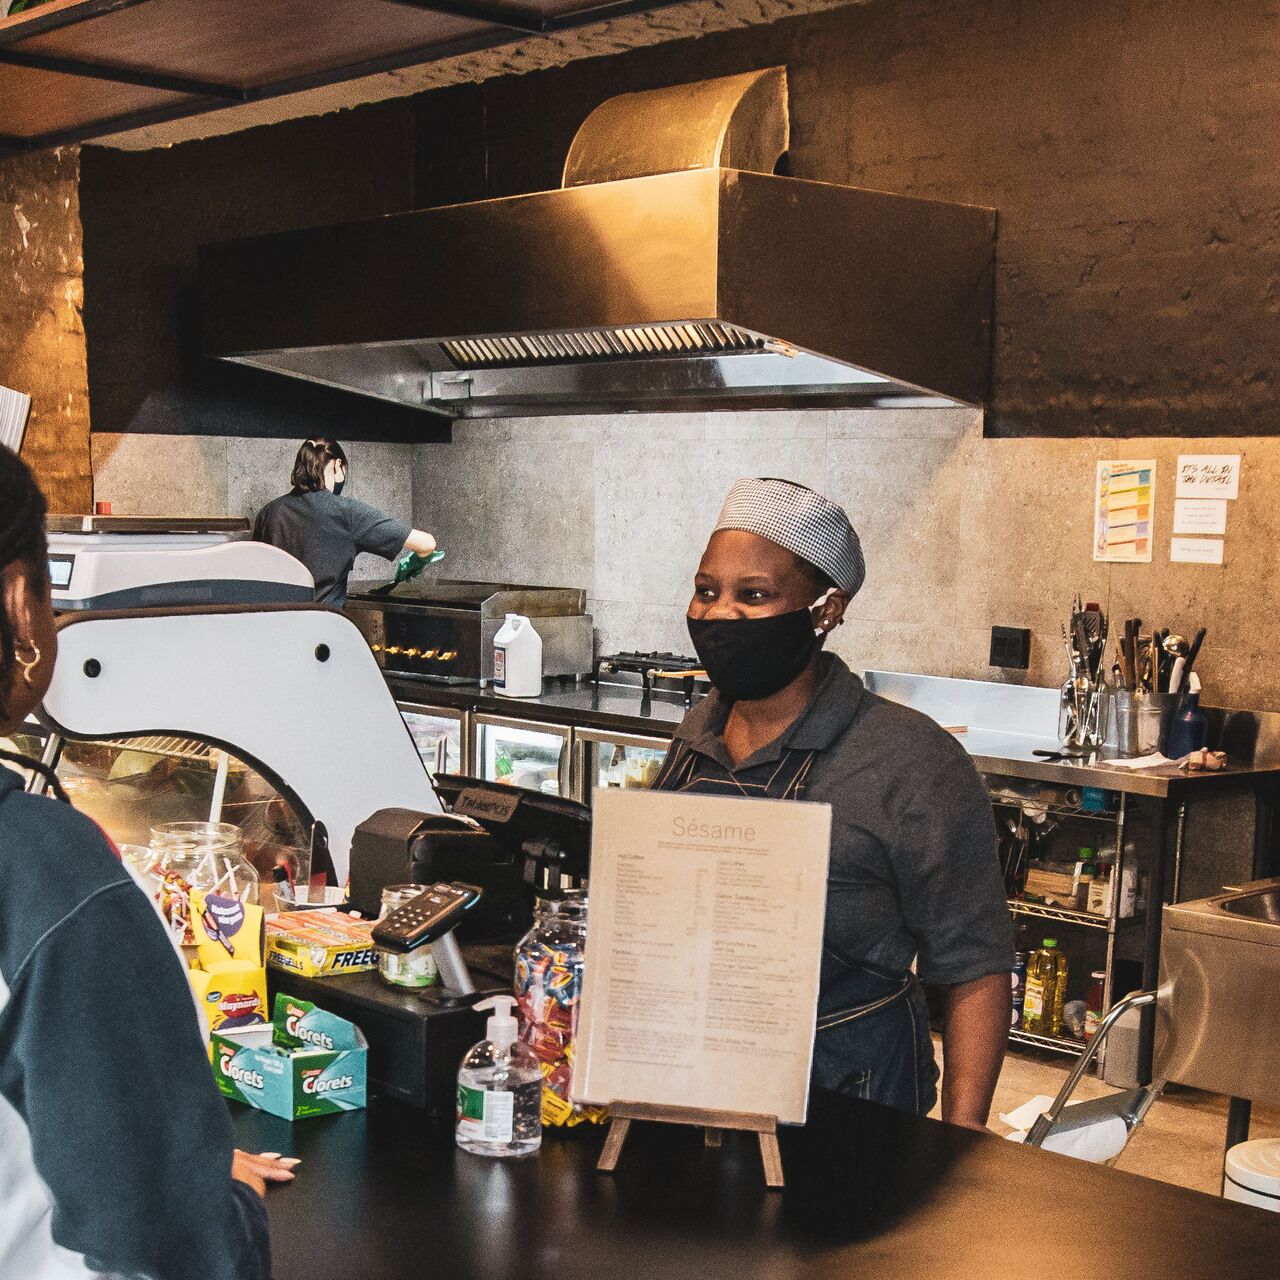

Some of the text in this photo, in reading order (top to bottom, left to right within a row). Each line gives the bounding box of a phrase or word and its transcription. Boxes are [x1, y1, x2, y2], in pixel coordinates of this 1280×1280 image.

[672, 816, 756, 843] Sésame
[331, 949, 380, 969] FREEG
[286, 1015, 334, 1050] Clorets
[220, 1055, 264, 1089] Clorets
[302, 1075, 353, 1095] Clorets
